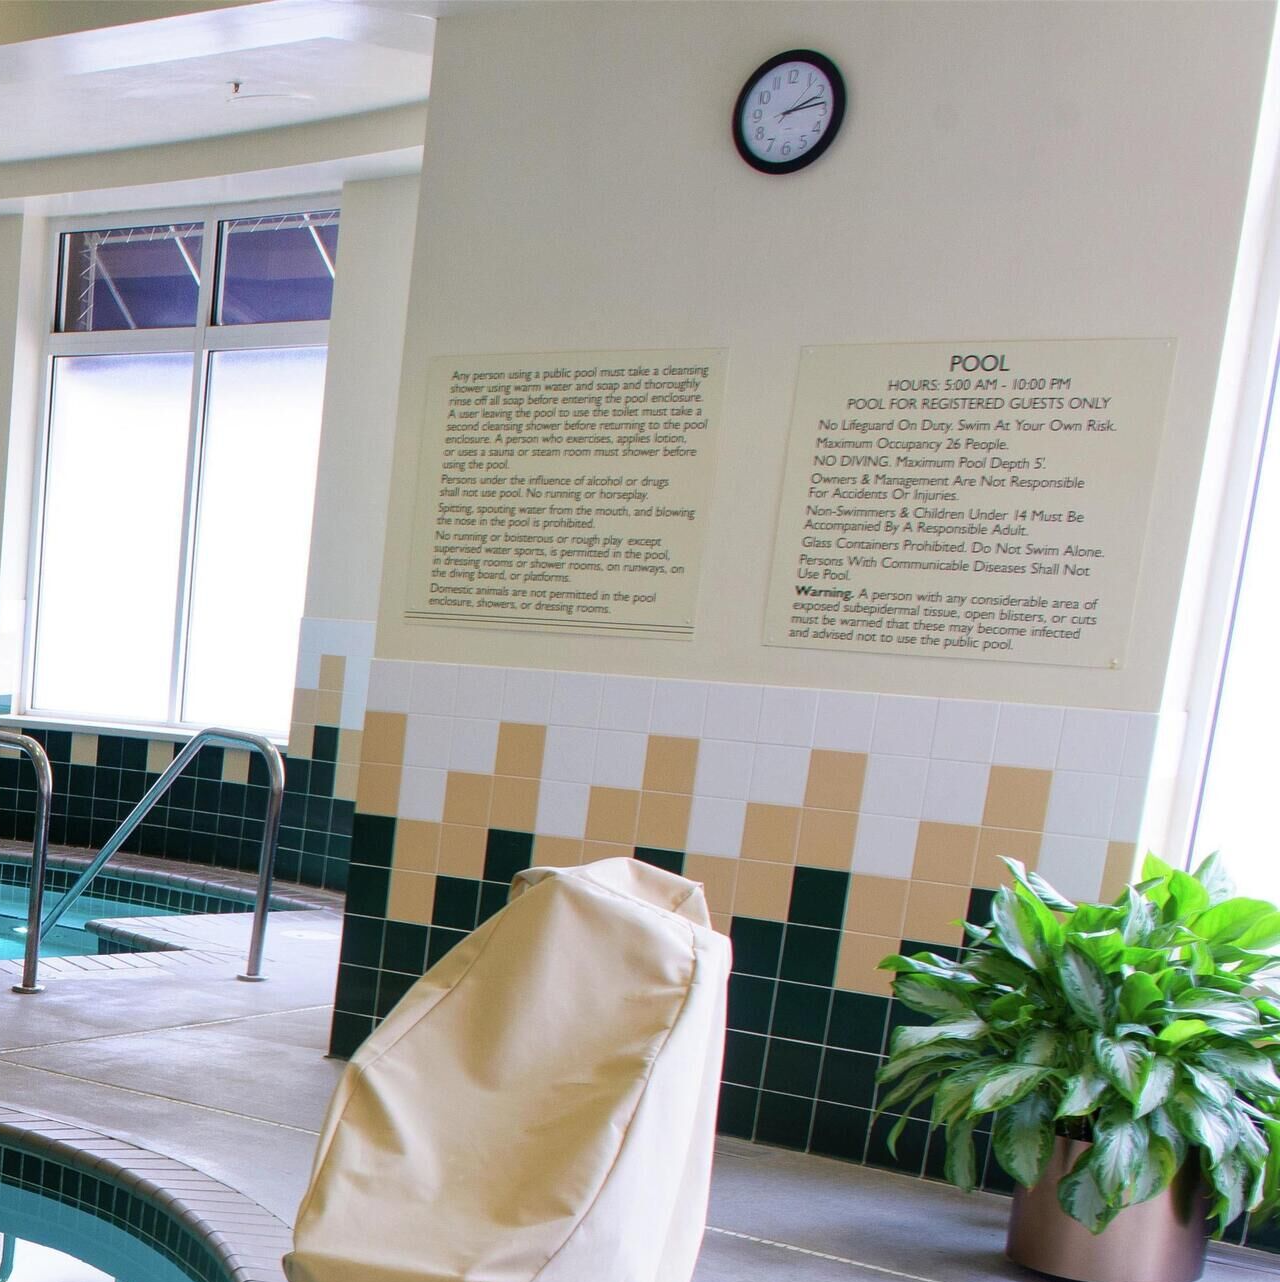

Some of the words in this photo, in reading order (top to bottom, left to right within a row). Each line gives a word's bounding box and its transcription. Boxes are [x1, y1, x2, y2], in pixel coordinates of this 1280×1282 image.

[772, 77, 782, 90] 11
[788, 69, 800, 85] 12
[758, 90, 772, 105] 10
[817, 85, 825, 98] 2
[753, 109, 763, 123] 9
[755, 126, 765, 140] 8
[812, 121, 821, 134] 4
[766, 138, 776, 153] 7
[782, 141, 791, 156] 6
[799, 135, 808, 150] 5
[949, 354, 1010, 372] POOL
[451, 371, 470, 380] Any
[472, 372, 505, 381] person
[507, 369, 533, 381] using
[542, 368, 571, 379] public
[573, 367, 597, 379] pool
[599, 368, 626, 376] must
[627, 366, 650, 376] take
[661, 365, 709, 377] cleansing
[449, 383, 485, 393] shower
[486, 384, 511, 394] using
[513, 384, 541, 392] warm
[544, 383, 573, 391] water
[574, 380, 593, 391] and
[596, 382, 620, 392] soap
[621, 379, 641, 390] and
[644, 378, 701, 391] thoroughly
[943, 379, 971, 390] 5:00
[973, 378, 997, 390] AM
[1011, 378, 1046, 390] 10:00
[1048, 378, 1071, 389] PM
[473, 396, 487, 405] off
[489, 395, 499, 405] all
[502, 397, 524, 406] soap
[527, 395, 558, 404] before
[560, 396, 602, 406] entering
[604, 394, 622, 403] the
[624, 393, 648, 404] pool
[846, 398, 886, 409] POOL
[888, 398, 917, 409] FOR
[920, 397, 1005, 409] REGISTERED
[1007, 397, 1064, 409] GUESTS
[1067, 397, 1112, 409] ONLY
[481, 408, 512, 420] leaving
[514, 408, 531, 417] the
[533, 407, 556, 419] pool
[572, 409, 589, 417] use
[591, 407, 609, 417] the
[611, 406, 639, 416] toilet
[641, 408, 668, 416] must
[669, 406, 693, 416] take
[817, 419, 838, 430] No
[840, 419, 894, 433] Lifeguard
[896, 419, 917, 430] On
[957, 419, 990, 431] Swim
[993, 419, 1010, 431] At
[1014, 419, 1046, 431] Your
[1048, 419, 1082, 431] Own
[815, 437, 873, 448] Maximum
[875, 437, 942, 452] Occupancy
[944, 437, 961, 449] 26
[812, 455, 837, 466] NO
[895, 456, 955, 468] Maximum
[957, 457, 987, 468] Pool
[989, 457, 1029, 471] Depth
[809, 472, 857, 484] Owners
[859, 473, 871, 484] &
[873, 473, 949, 488] Management
[951, 475, 976, 486] Are
[979, 475, 1006, 487] Not
[1009, 476, 1085, 490] Responsible
[807, 487, 829, 498] For
[830, 487, 888, 499] Accidents
[891, 488, 910, 499] Or
[805, 504, 896, 517] Non-Swimmers
[898, 507, 909, 518] &
[912, 507, 964, 519] Children
[967, 508, 1008, 520] Under
[1013, 510, 1027, 520] 14
[1029, 510, 1063, 522] Must
[1065, 511, 1084, 522] Be
[802, 518, 881, 533] Accompanied
[883, 521, 899, 535] By
[901, 521, 913, 532] A
[916, 521, 988, 536] Responsible
[800, 536, 832, 548] Glass
[834, 537, 899, 550] Containers
[970, 541, 992, 553] Do
[994, 542, 1022, 555] Not
[1024, 543, 1059, 555] Swim
